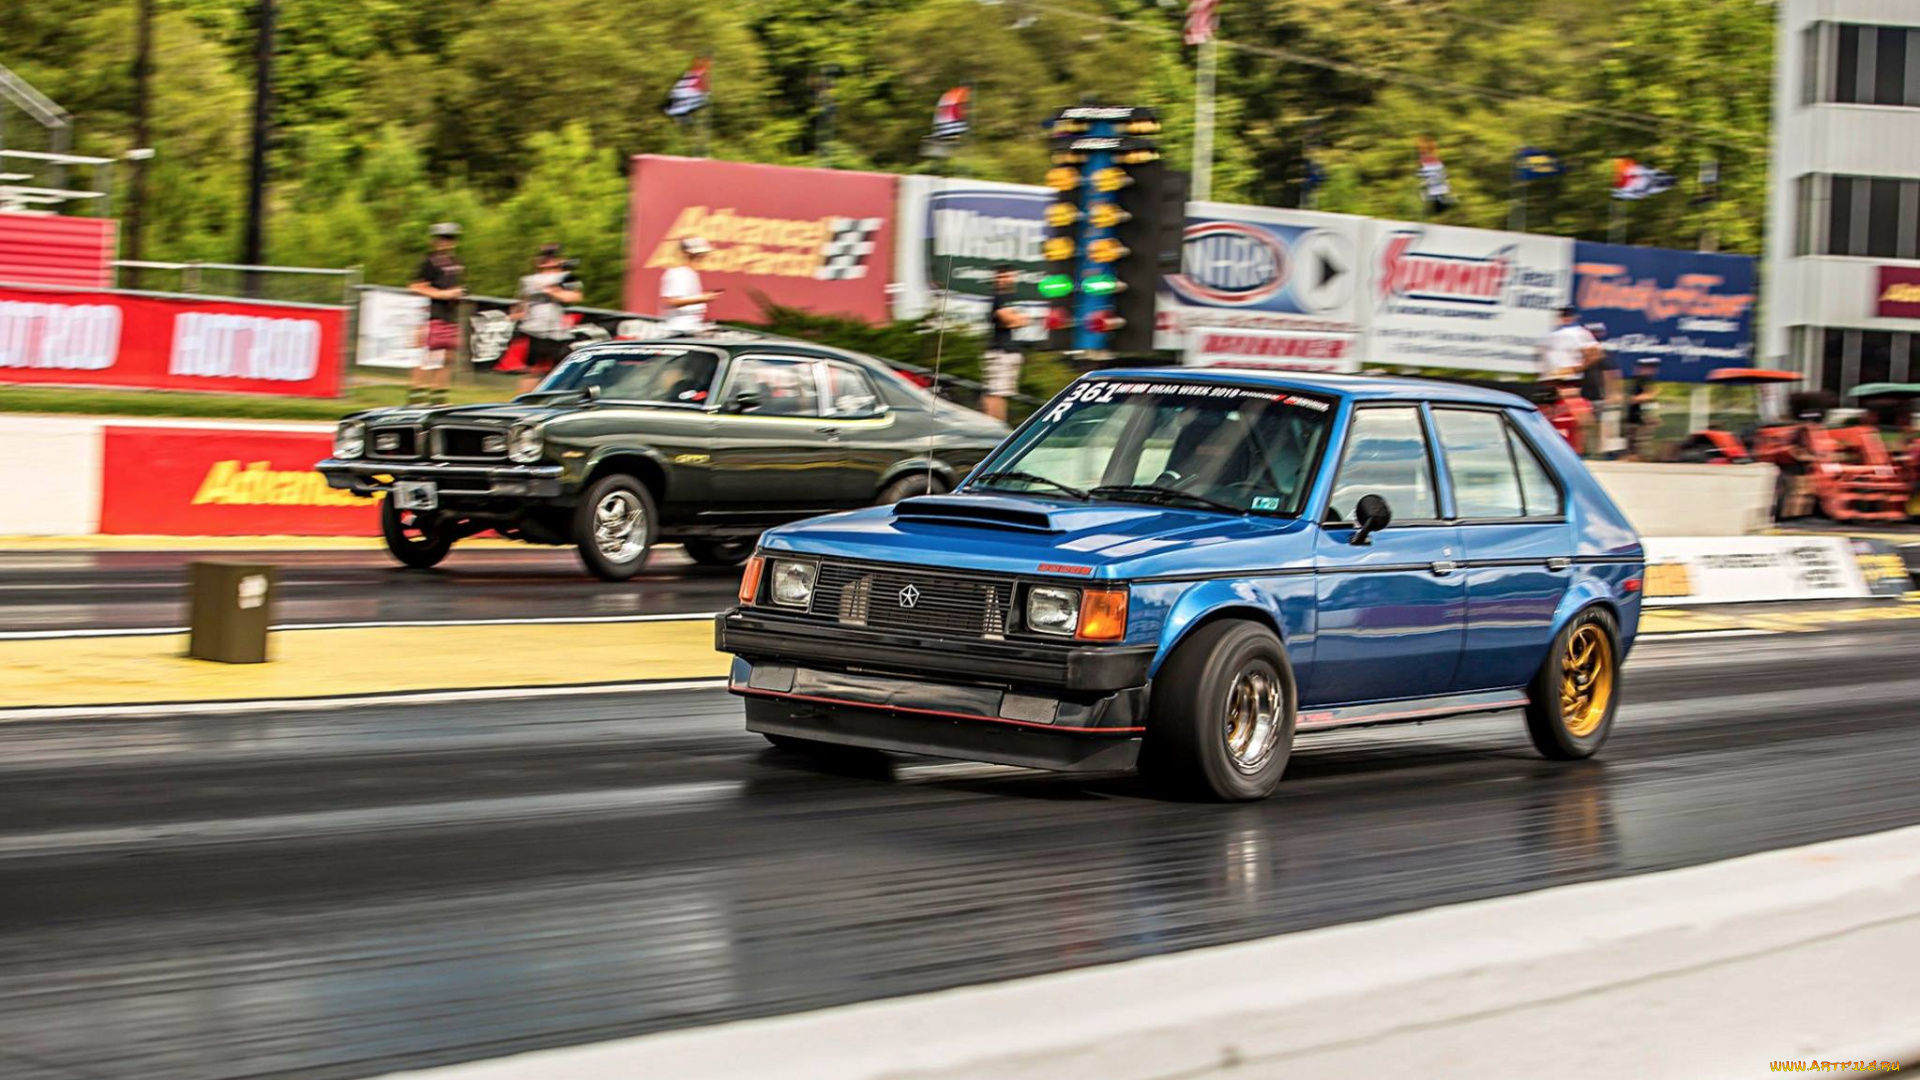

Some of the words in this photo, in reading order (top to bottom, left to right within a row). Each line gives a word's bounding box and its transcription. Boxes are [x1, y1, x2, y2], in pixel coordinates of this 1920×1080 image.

[168, 312, 255, 378] HOT
[247, 315, 323, 381] ROD
[1063, 382, 1119, 404] 361
[1178, 385, 1213, 396] WEEK
[1042, 402, 1074, 423] R
